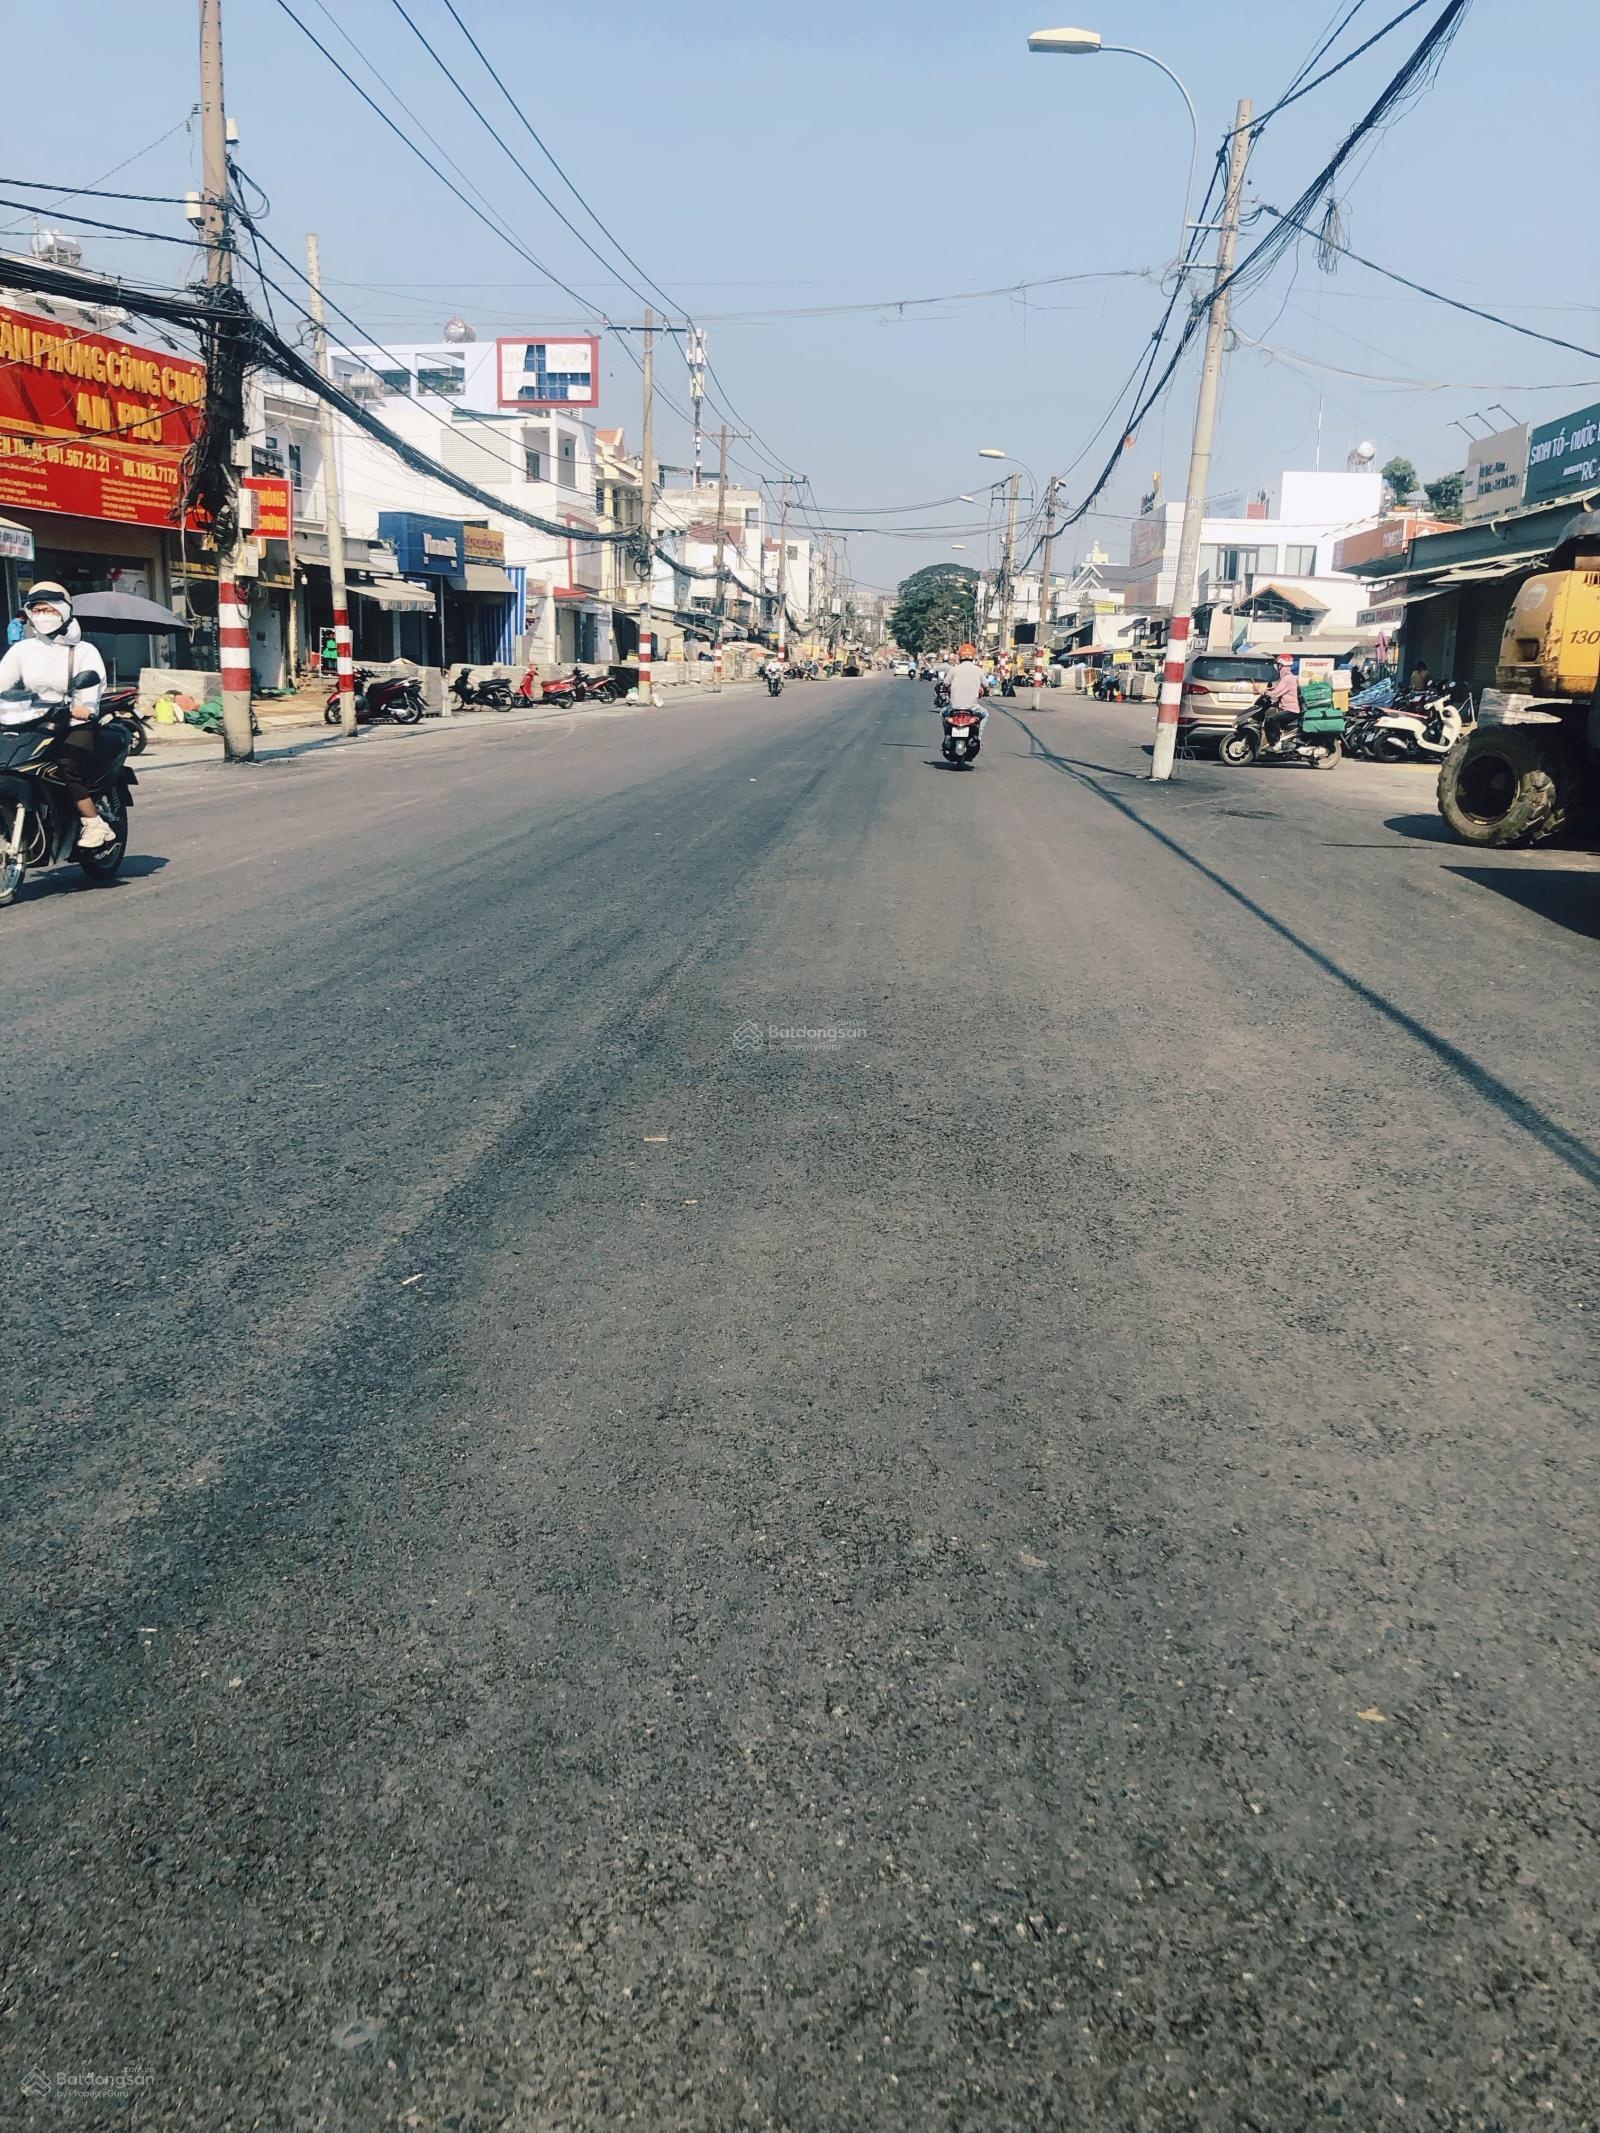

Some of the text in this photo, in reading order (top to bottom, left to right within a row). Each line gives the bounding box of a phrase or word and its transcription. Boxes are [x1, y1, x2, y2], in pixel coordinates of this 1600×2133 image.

[0, 313, 32, 365] ĂN
[32, 326, 107, 384] PHÒNG
[106, 346, 162, 397] CÔNG
[77, 392, 163, 443] AN PHÚ
[1530, 440, 1552, 466] SINH
[1552, 427, 1566, 458] TỐ
[259, 486, 287, 508] HÒNG
